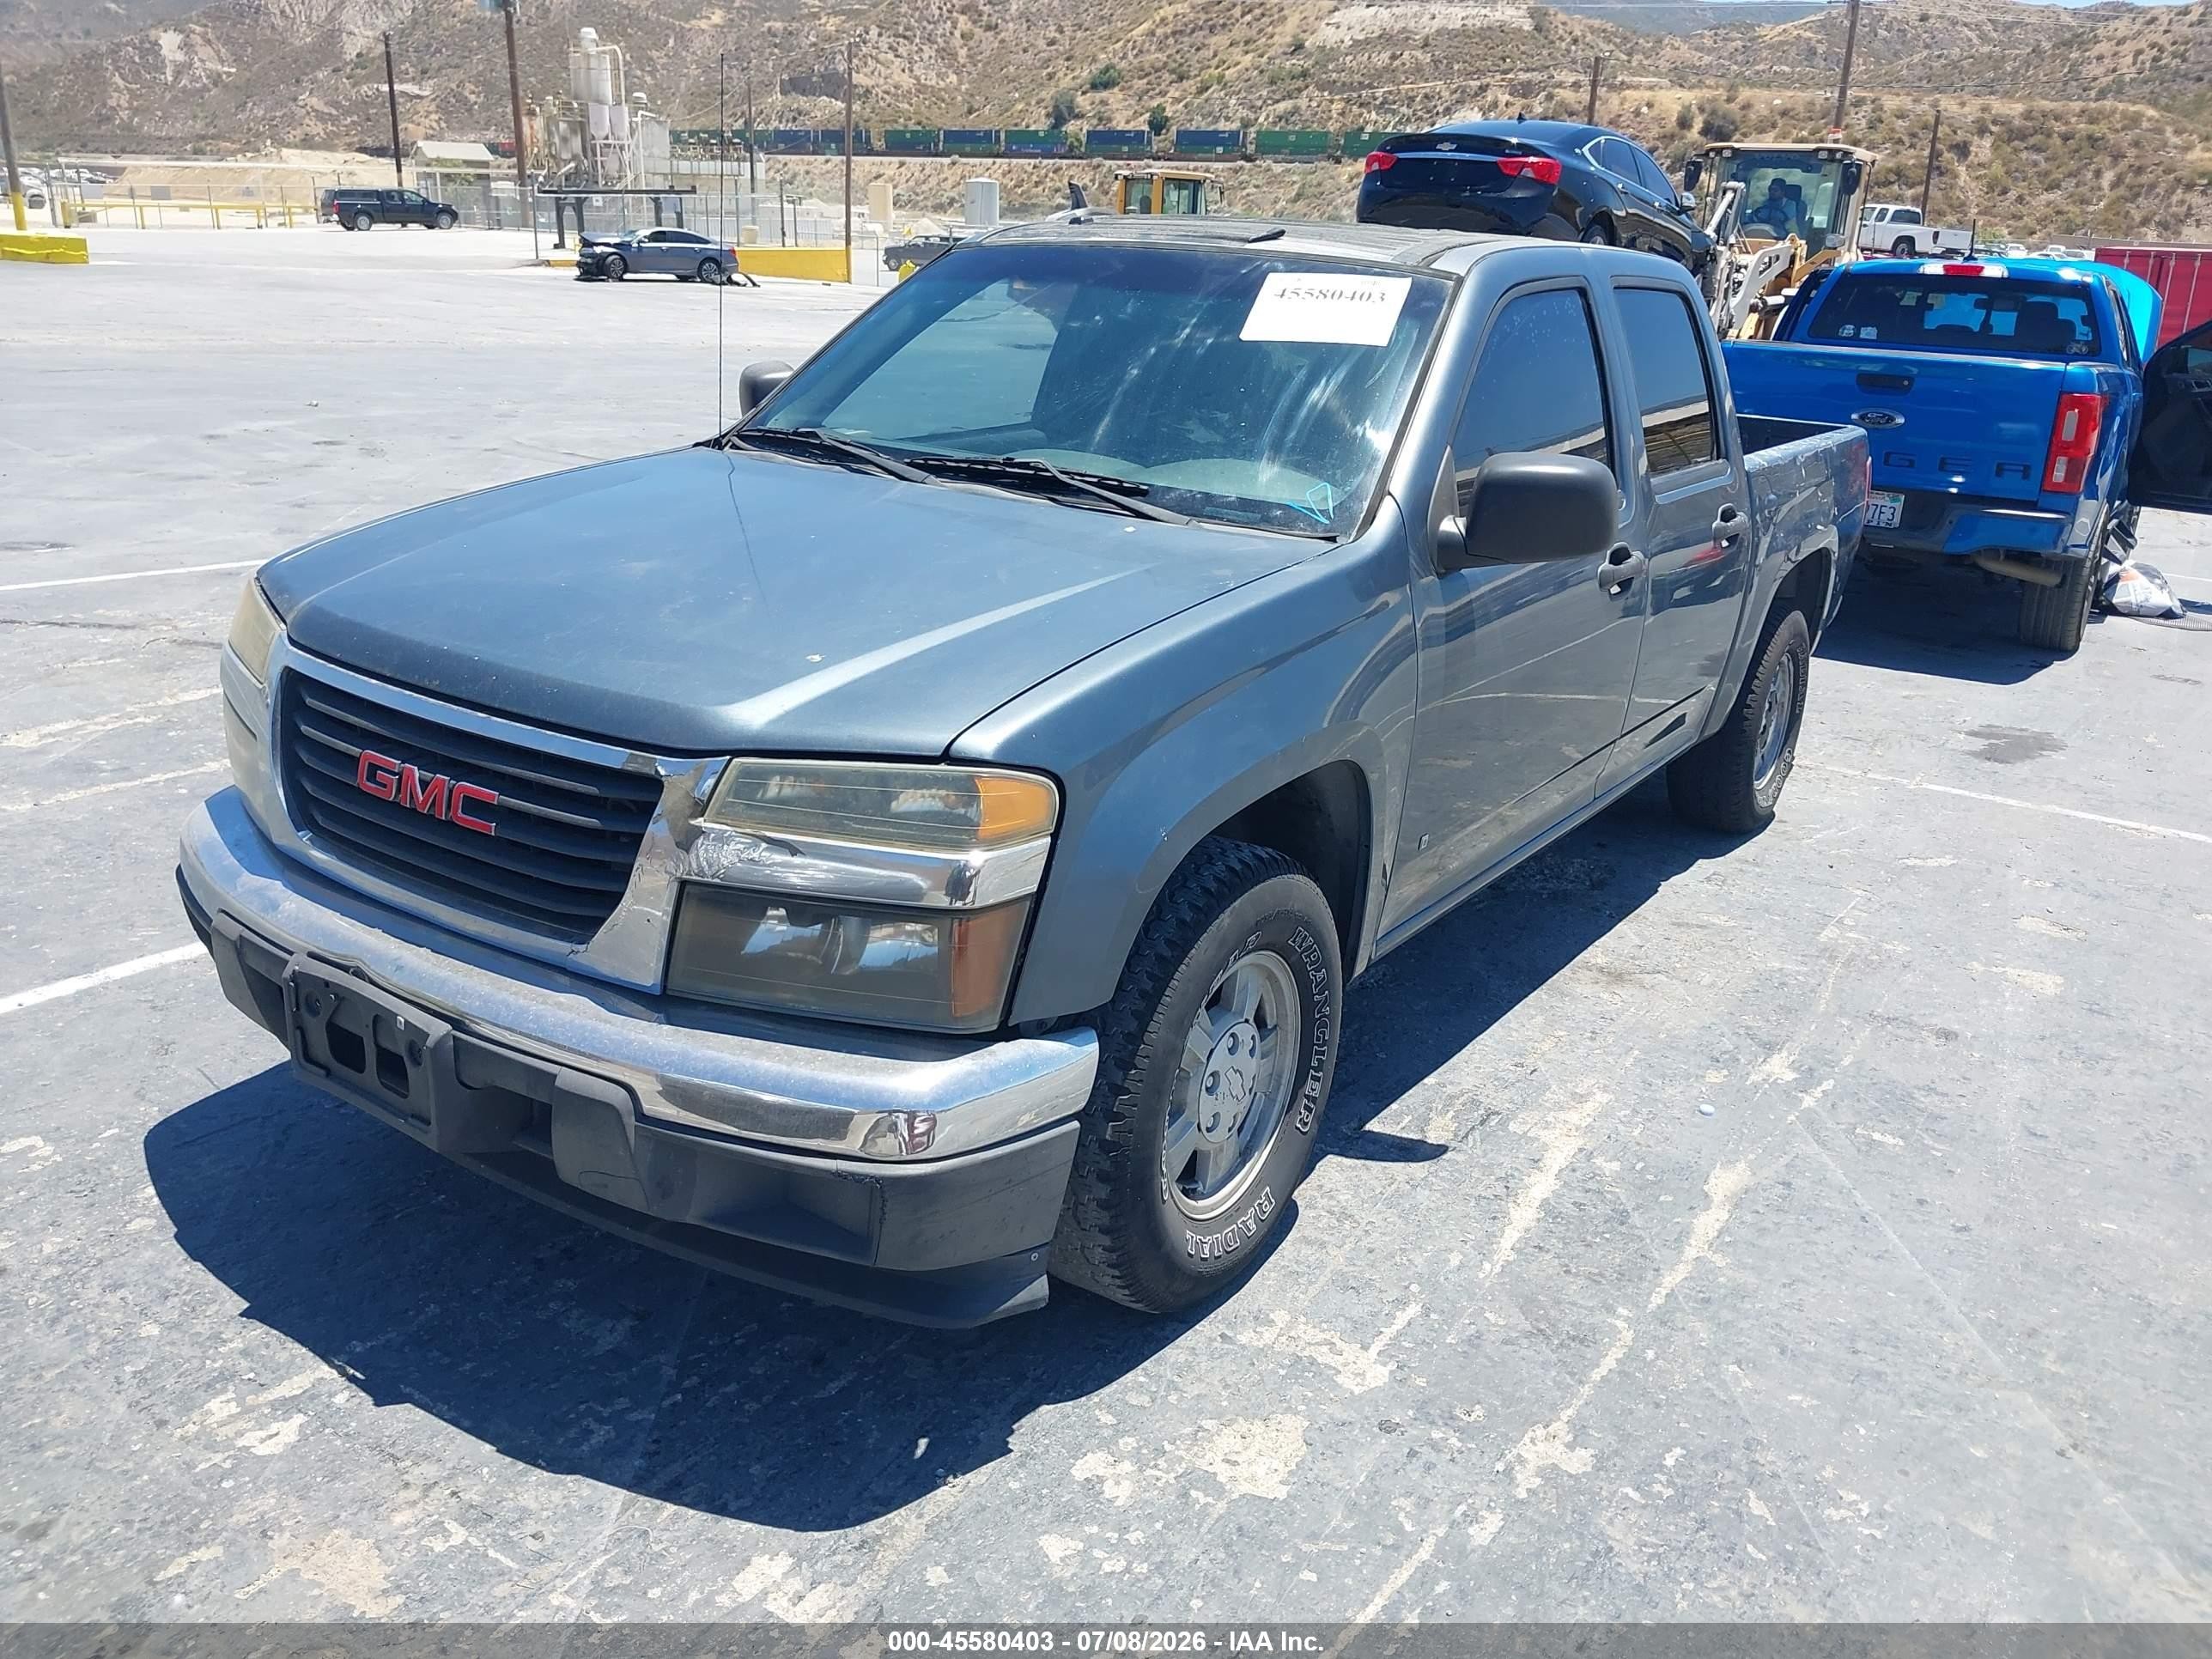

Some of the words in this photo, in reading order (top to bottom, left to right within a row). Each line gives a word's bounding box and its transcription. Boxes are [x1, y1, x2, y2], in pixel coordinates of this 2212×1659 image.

[1273, 288, 1386, 302] 45580403
[1868, 503, 1897, 522] 7F3
[357, 750, 499, 836] GMC
[1288, 927, 1330, 1133] WRANGLER
[1186, 1186, 1275, 1258] RADIAL
